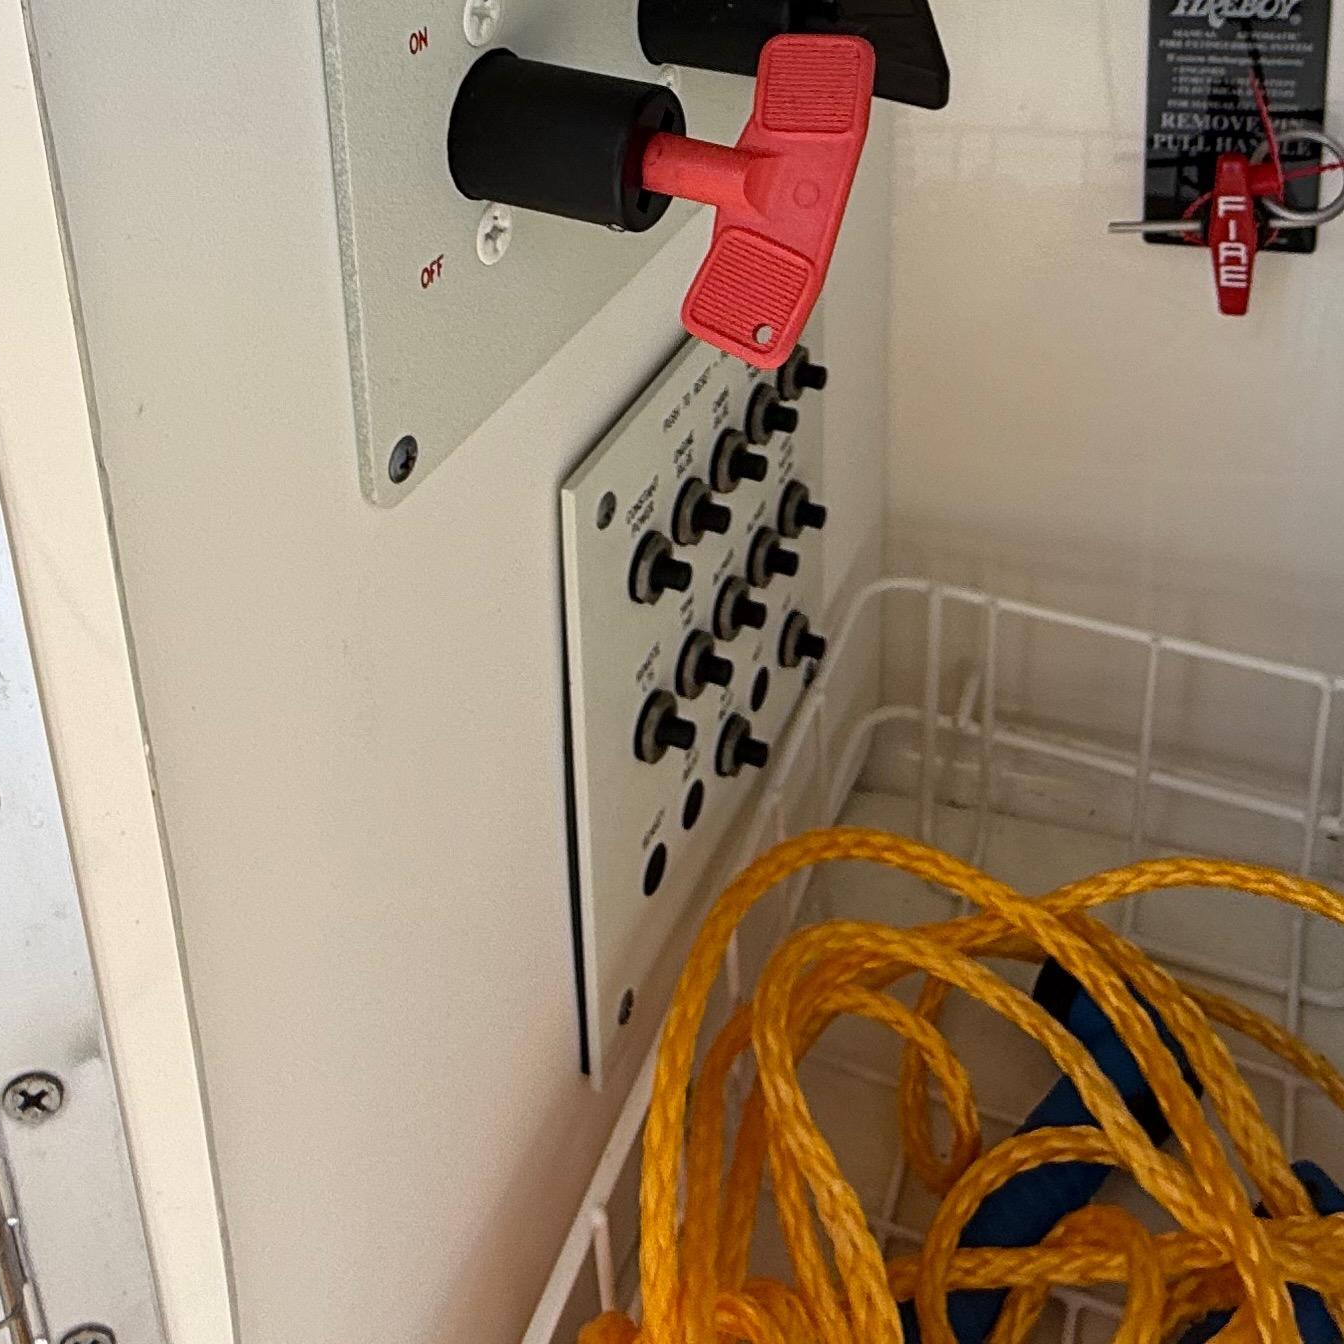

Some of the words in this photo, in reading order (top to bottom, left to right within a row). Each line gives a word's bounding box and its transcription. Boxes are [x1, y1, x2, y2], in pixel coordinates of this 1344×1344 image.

[409, 26, 428, 55] ON
[1153, 133, 1211, 153] PULL
[1217, 196, 1249, 288] FIRE
[421, 254, 444, 289] OFF
